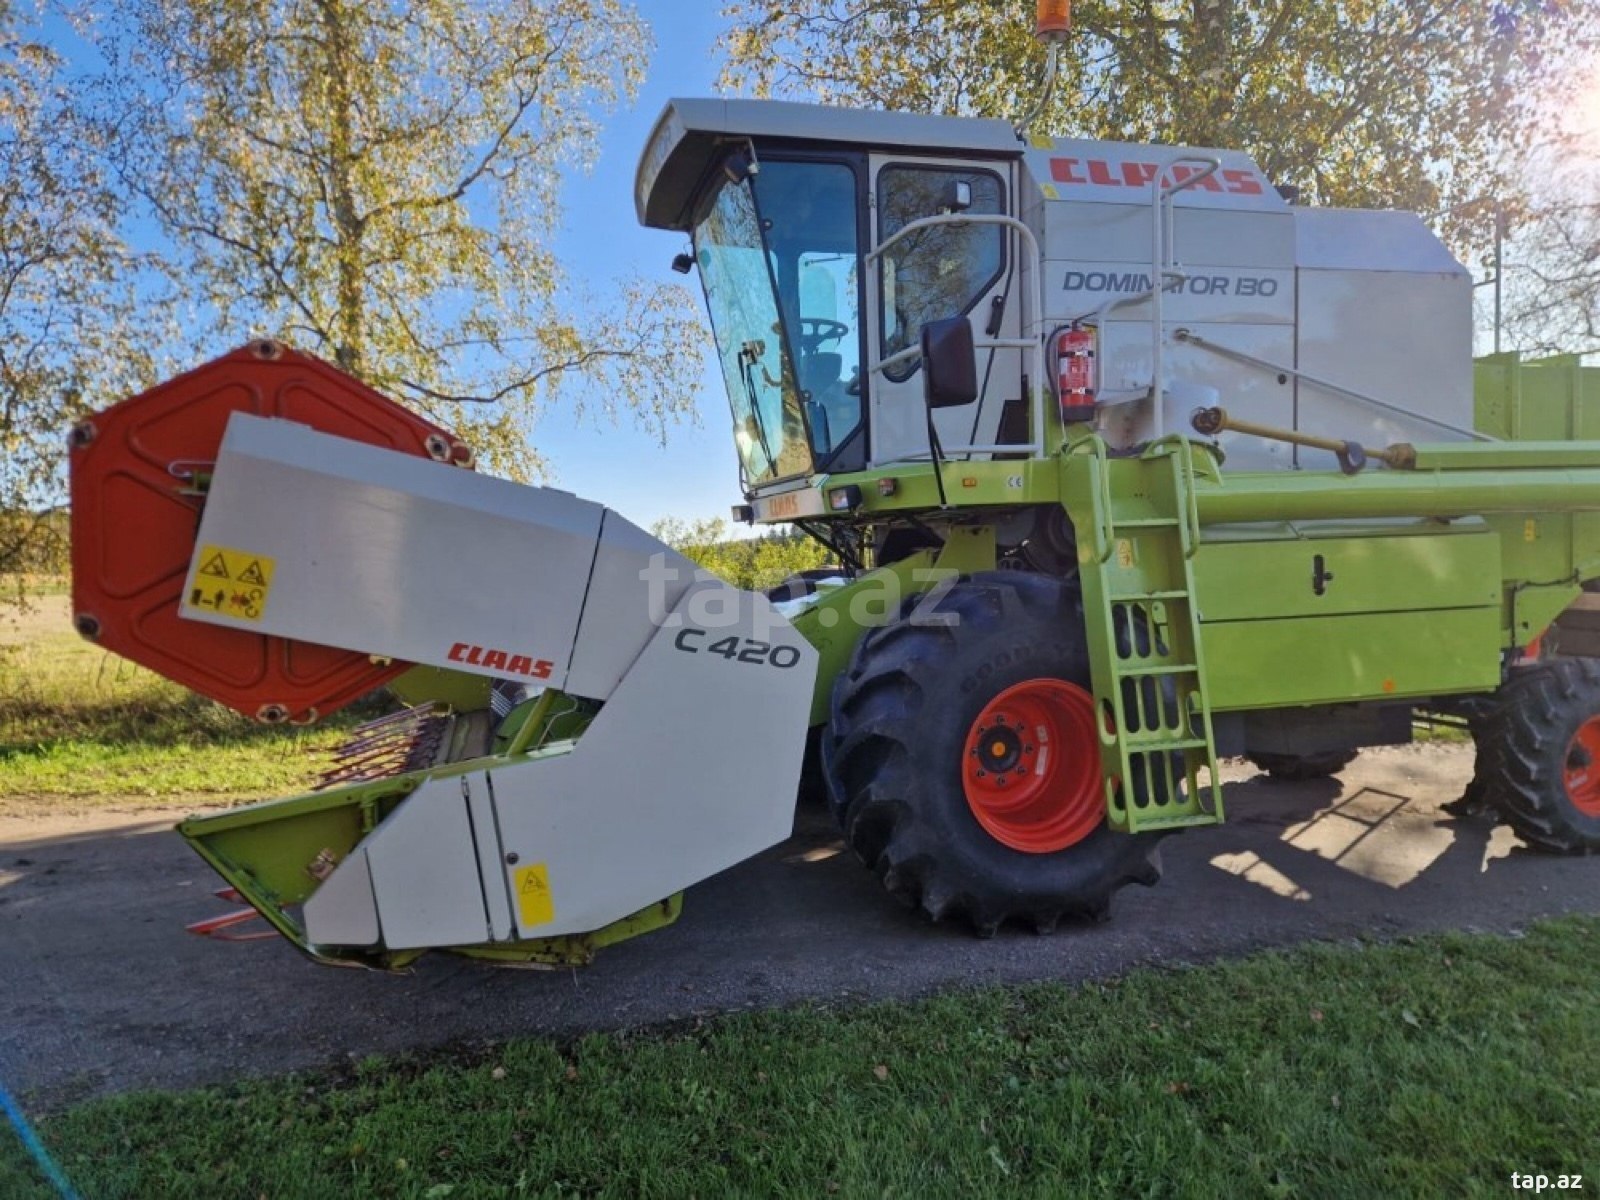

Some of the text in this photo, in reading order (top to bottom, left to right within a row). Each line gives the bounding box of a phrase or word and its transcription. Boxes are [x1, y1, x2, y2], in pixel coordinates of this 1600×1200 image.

[1049, 157, 1263, 195] CLAAS
[1234, 276, 1278, 297] 130
[447, 642, 554, 679] CLAAS
[674, 628, 801, 668] C 420
